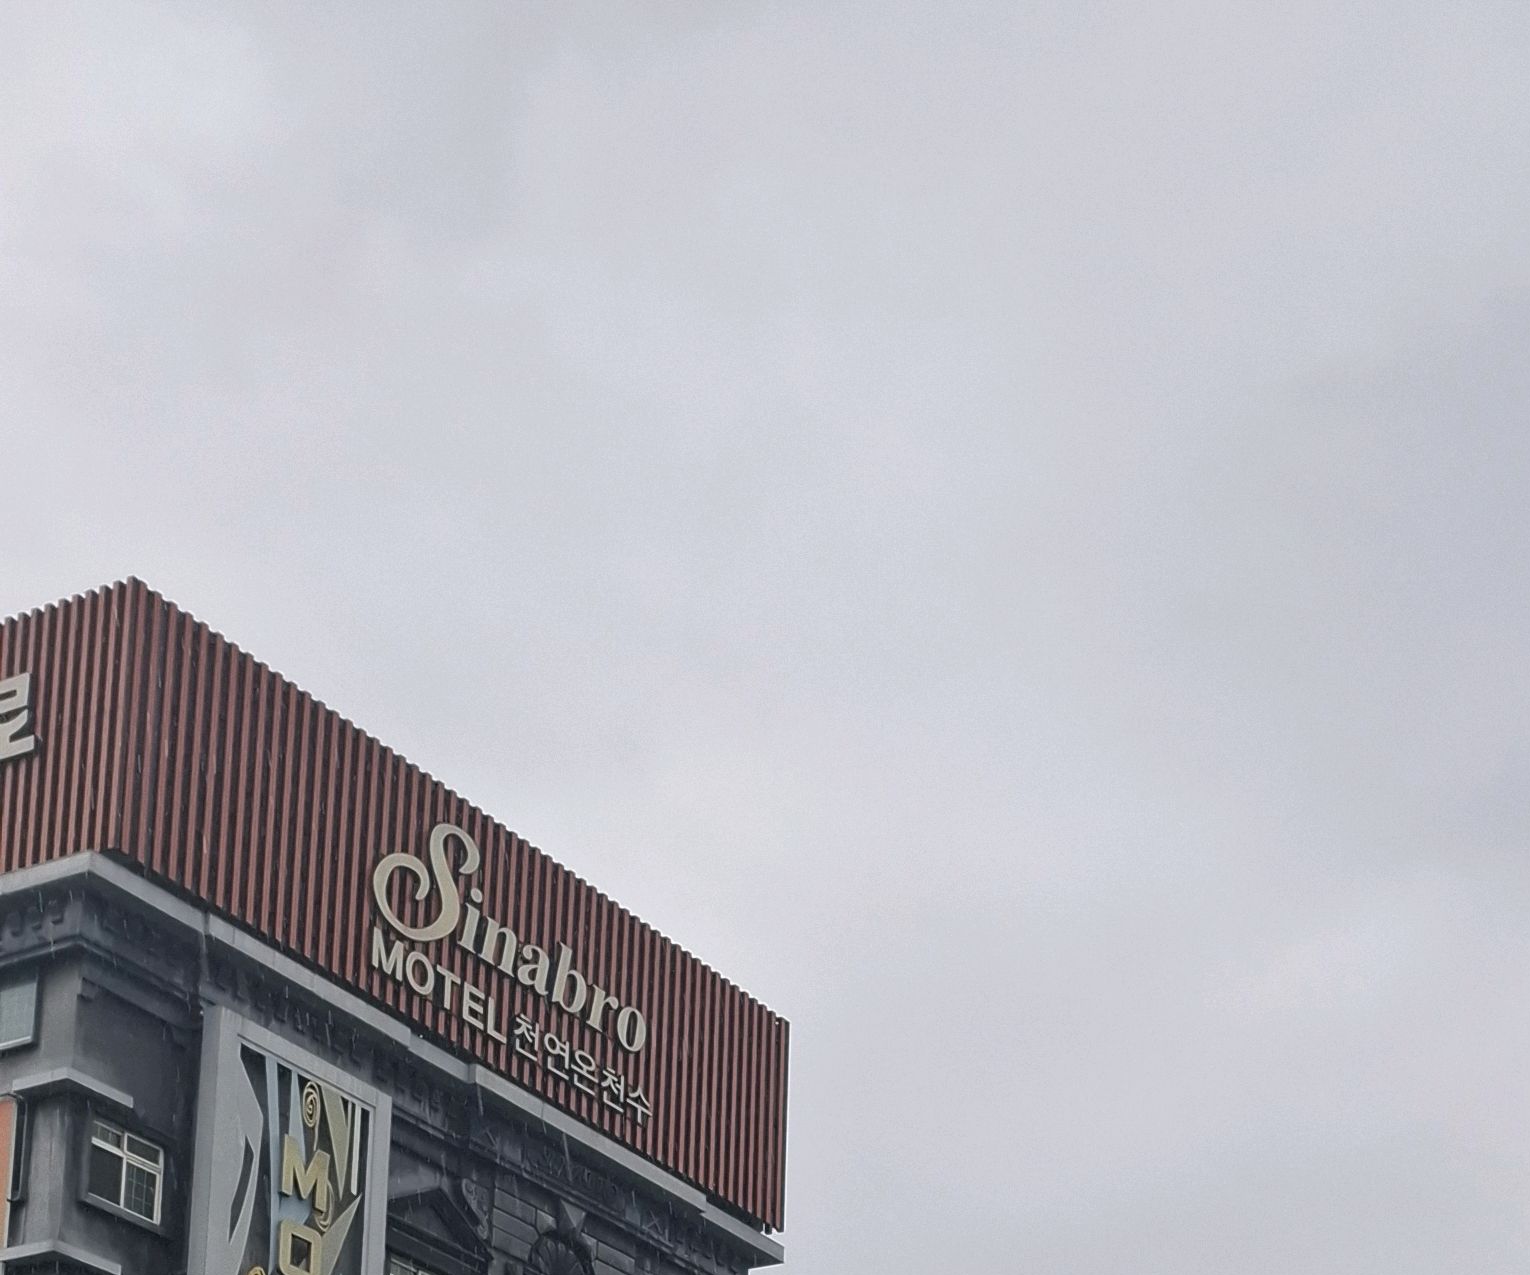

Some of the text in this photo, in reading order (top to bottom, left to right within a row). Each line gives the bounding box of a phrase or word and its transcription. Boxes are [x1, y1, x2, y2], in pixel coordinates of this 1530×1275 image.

[371, 926, 652, 1123] MOTEL 천연온천수
[373, 823, 648, 1052] Sinabro
